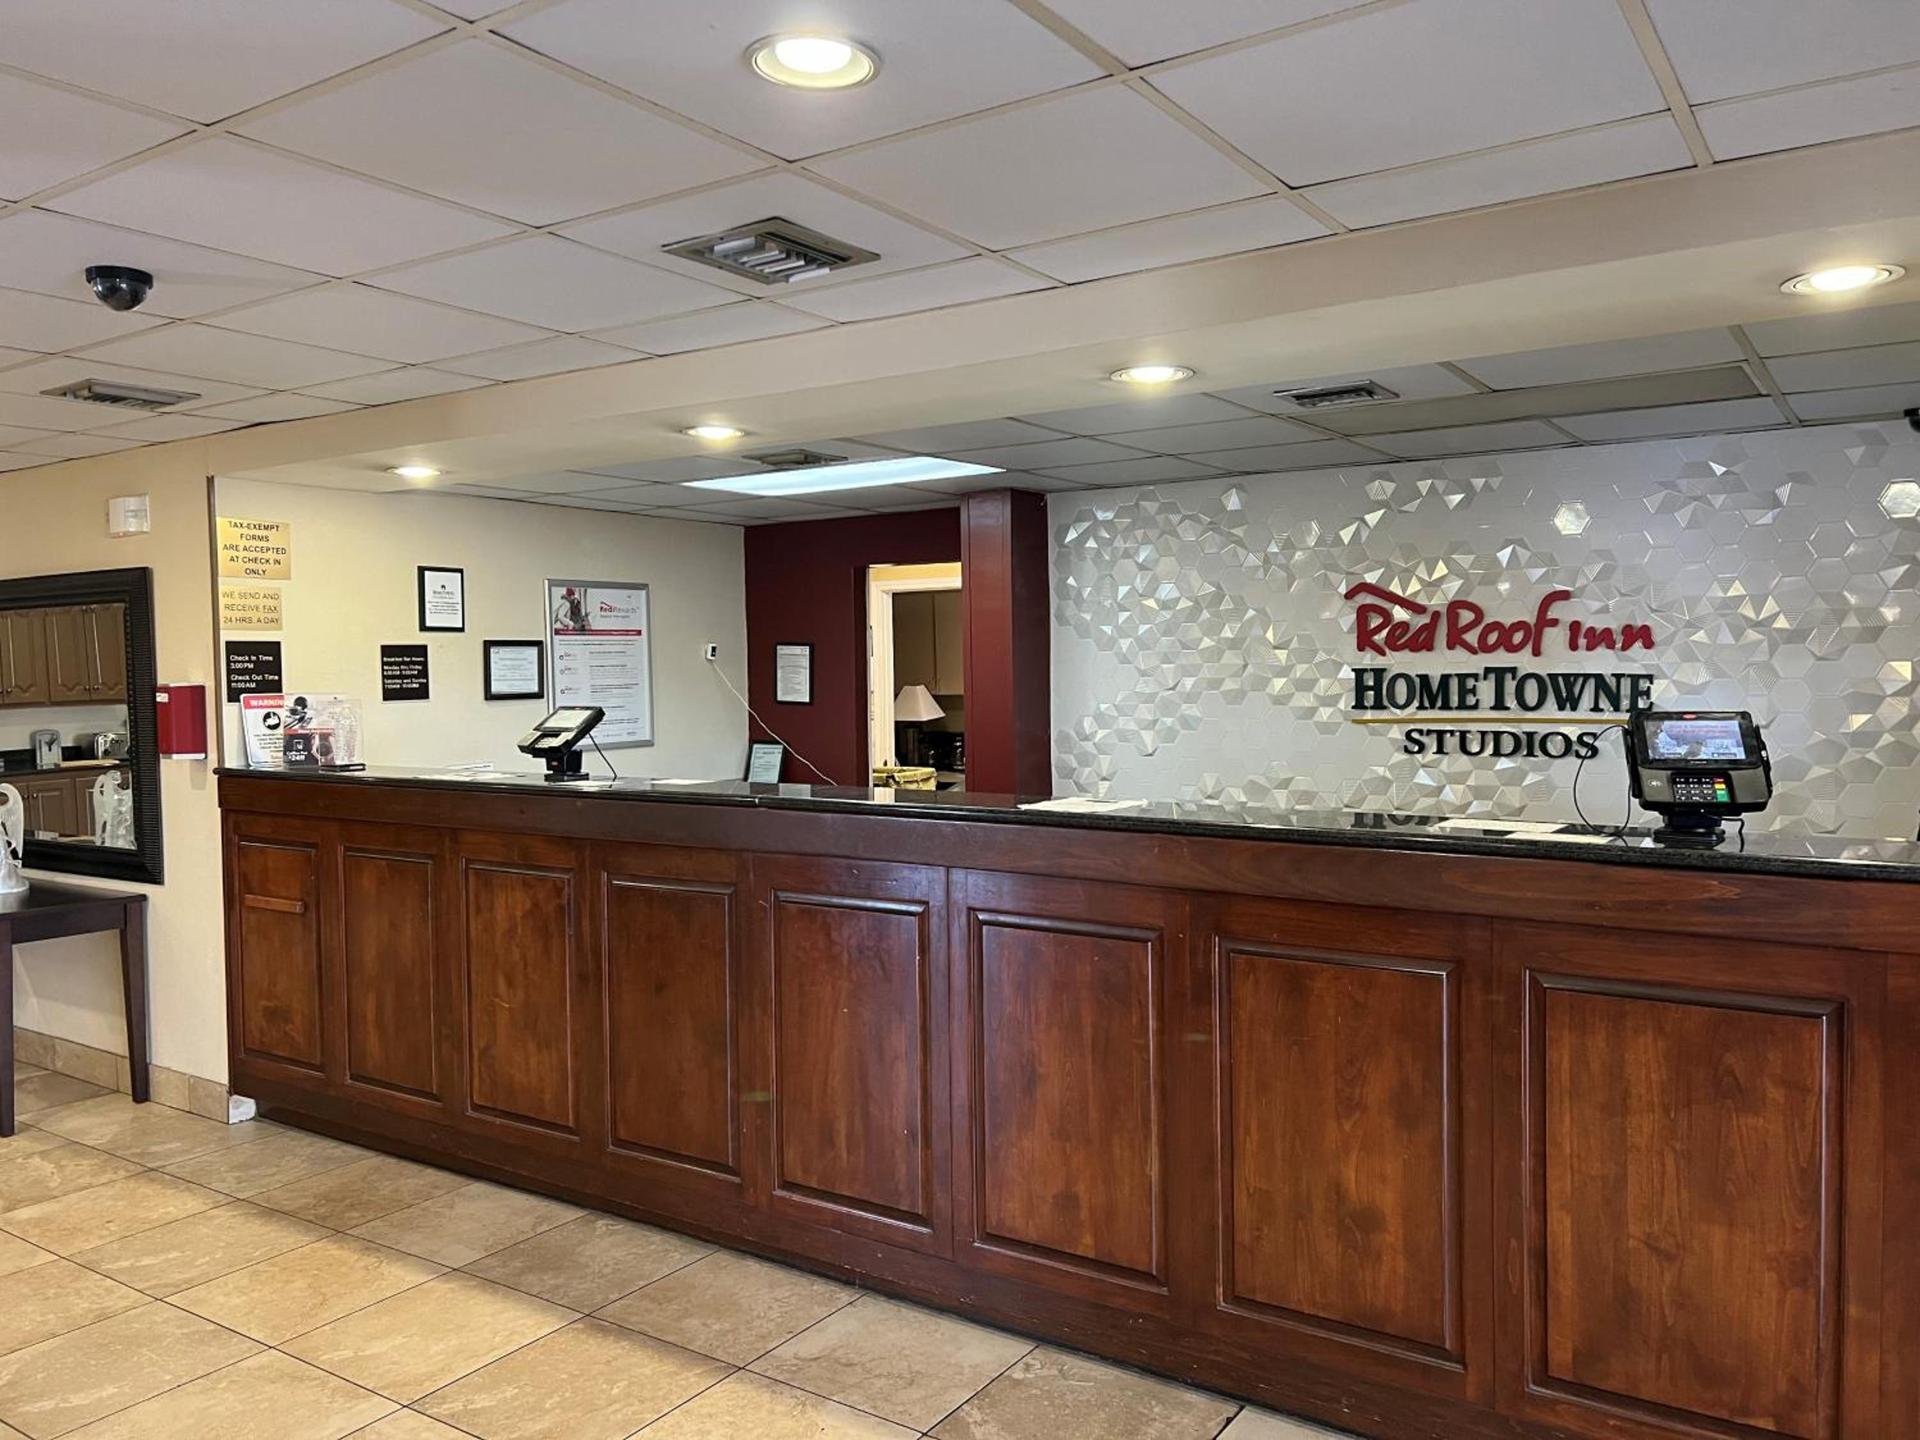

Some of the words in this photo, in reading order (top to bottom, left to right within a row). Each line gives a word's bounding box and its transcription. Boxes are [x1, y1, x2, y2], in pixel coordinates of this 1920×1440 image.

[228, 520, 280, 532] TAX-EXEMPT
[240, 533, 270, 542] FORMS
[222, 544, 240, 552] ARE
[242, 545, 287, 555] ACCEPTED
[229, 555, 240, 563] AT
[242, 556, 271, 565] CHECK
[273, 558, 281, 566] IN
[244, 567, 267, 576] ONLY
[222, 591, 236, 599] WE
[238, 591, 260, 600] SEND
[262, 592, 280, 601] AND
[224, 603, 261, 612] RECEIVE
[263, 604, 279, 613] FAX
[223, 616, 233, 624] 24
[263, 617, 280, 625] DAY
[1355, 602, 1441, 657] Red
[1446, 589, 1571, 657] Roof
[1403, 728, 1599, 760] STUDIOS
